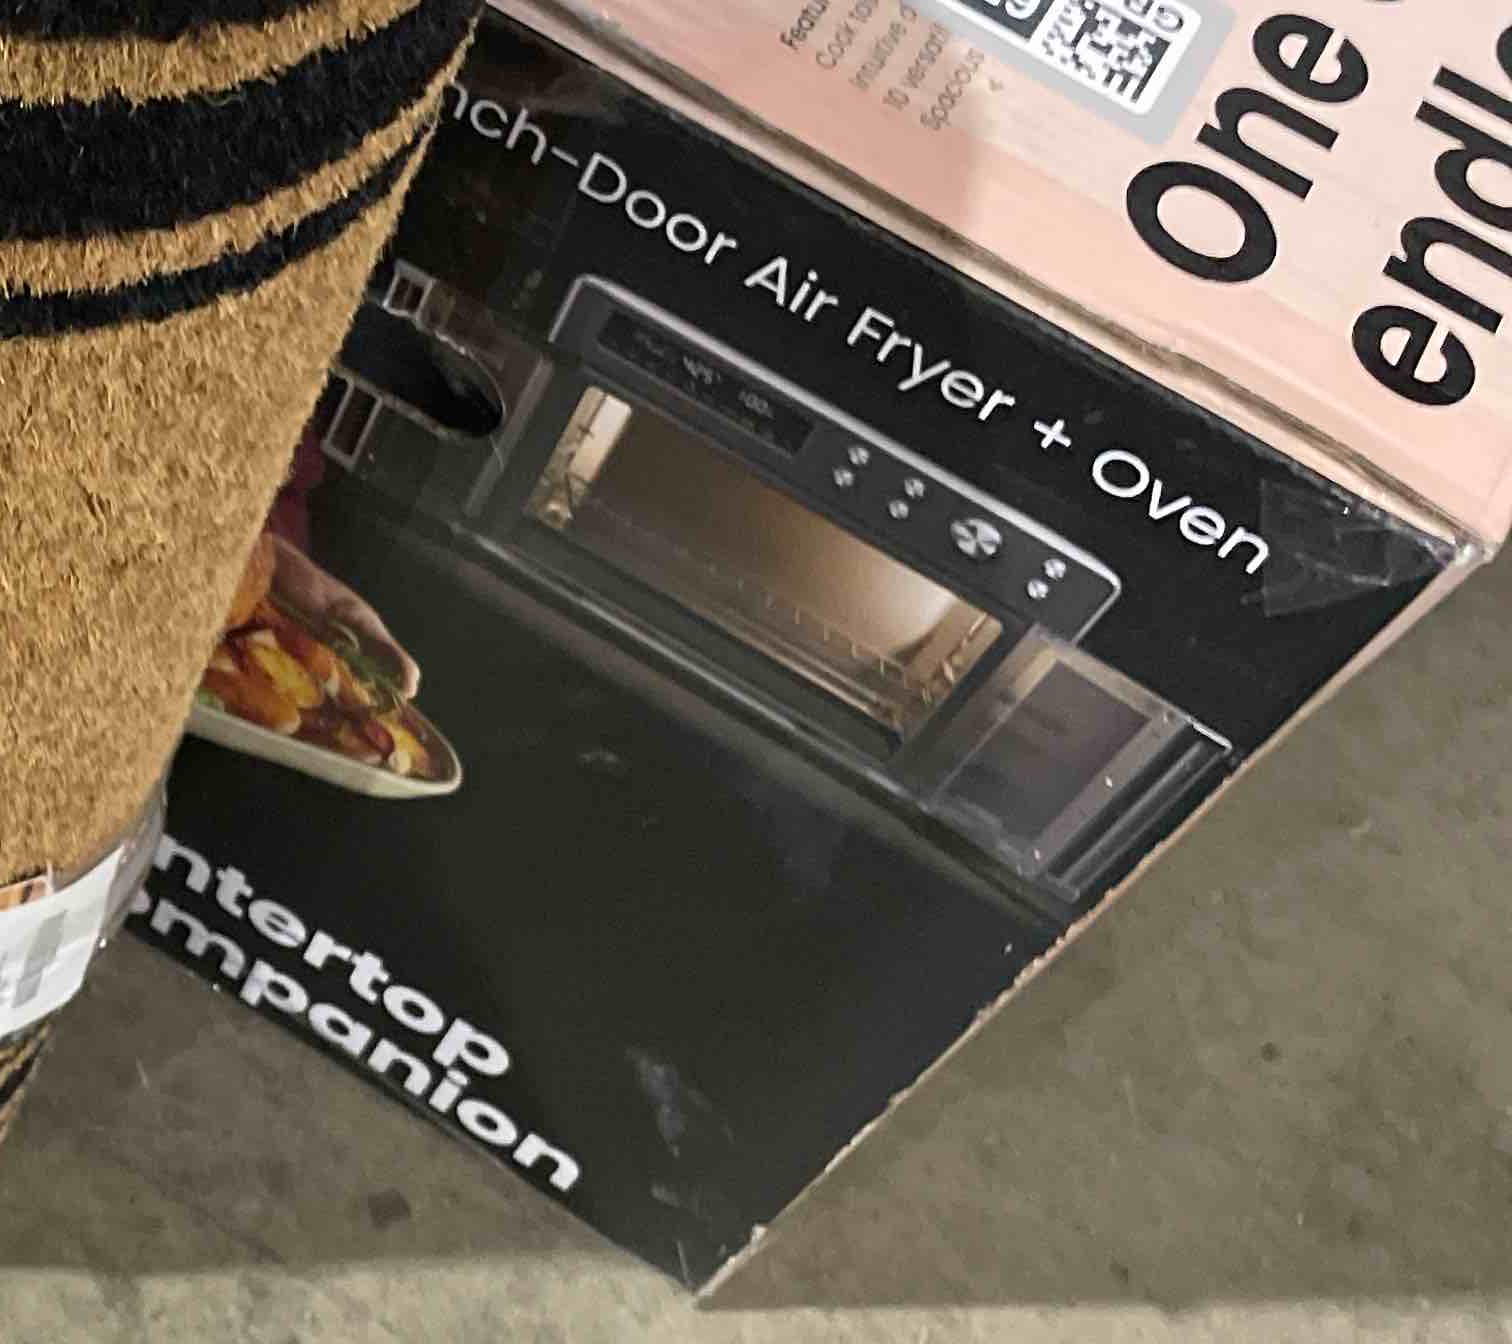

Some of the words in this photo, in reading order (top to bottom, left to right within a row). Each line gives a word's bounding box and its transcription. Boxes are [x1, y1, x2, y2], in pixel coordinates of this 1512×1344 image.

[1125, 12, 1370, 285] One
[1351, 22, 1512, 406] endl
[744, 256, 839, 324] Air
[846, 307, 1015, 424] Fryer
[1032, 414, 1073, 452] +
[1091, 449, 1270, 575] Oven
